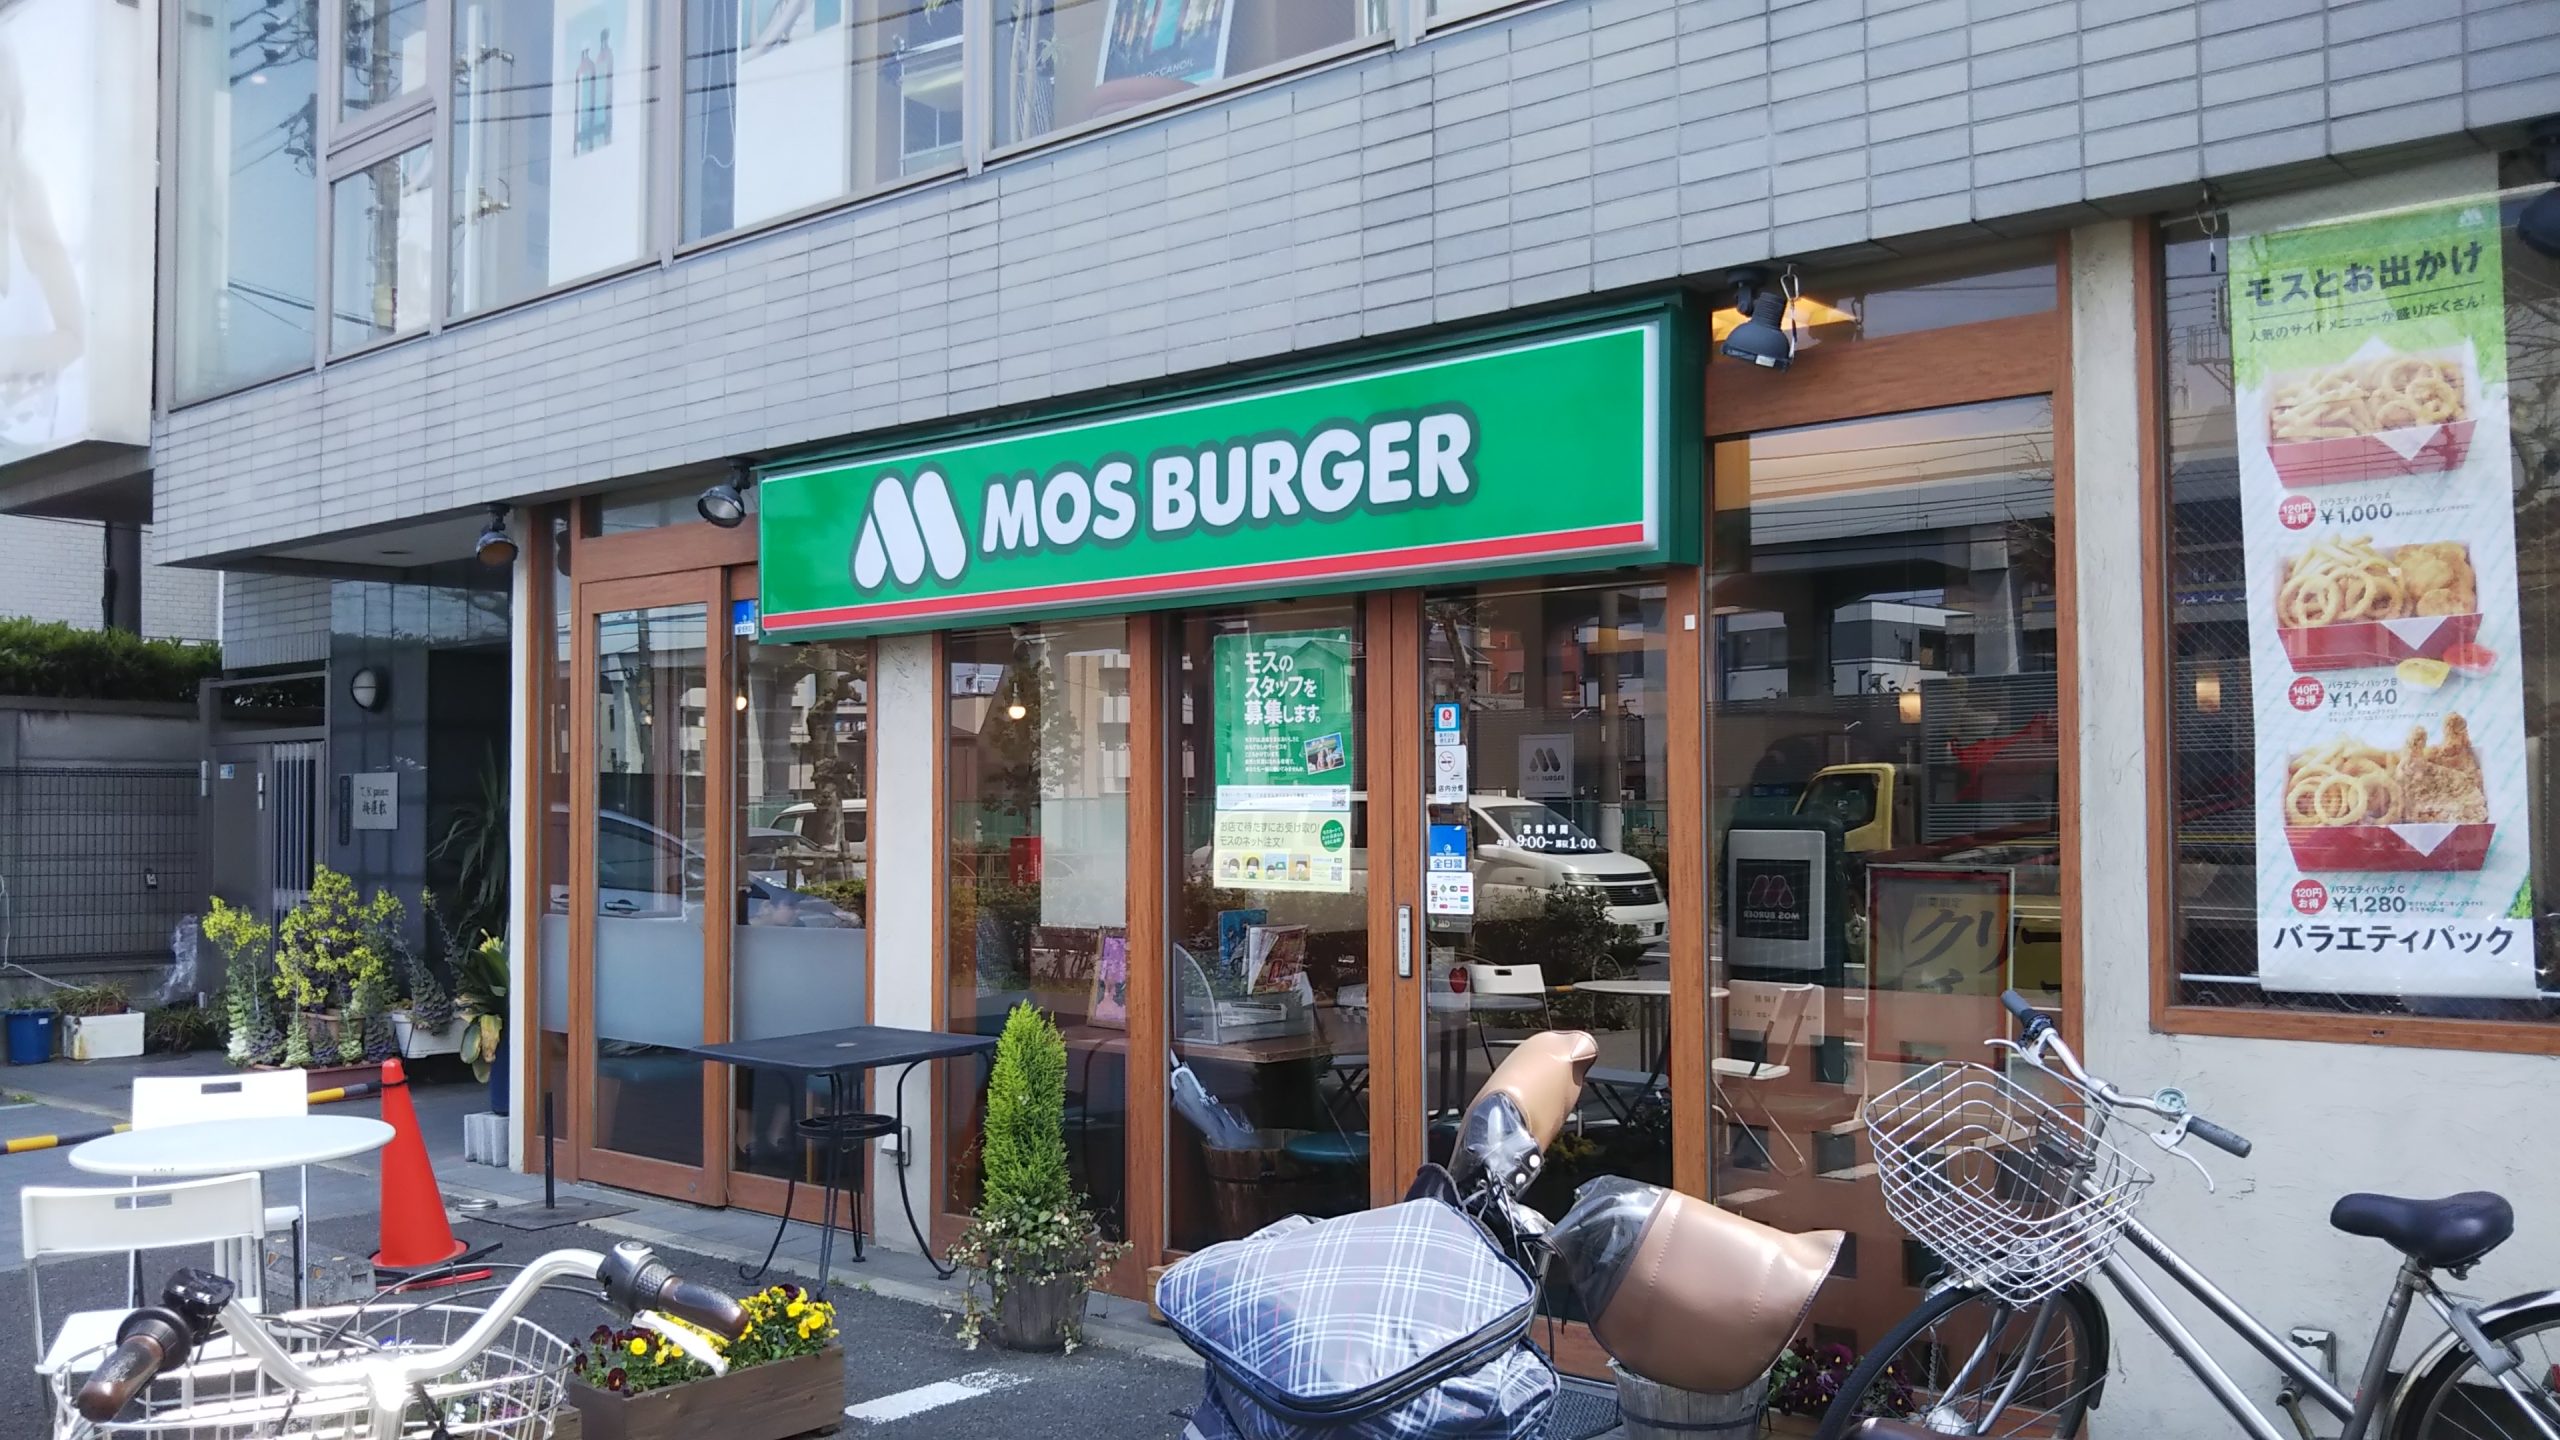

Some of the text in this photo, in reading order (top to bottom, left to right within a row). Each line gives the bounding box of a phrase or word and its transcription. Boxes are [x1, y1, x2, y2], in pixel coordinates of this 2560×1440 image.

[1136, 57, 1195, 79] OCCANOIL
[2245, 241, 2484, 307] モスとお出かけ
[981, 460, 1137, 553] MOS
[1151, 413, 1472, 533] BURGER
[2283, 503, 2312, 514] 120円
[2320, 502, 2394, 525] ¥1,000
[2287, 513, 2308, 525] お得
[1244, 651, 1294, 675] モスの
[1244, 676, 1317, 699] スタッフを
[2293, 684, 2319, 696] 140円
[2295, 695, 2317, 706] お得
[2328, 688, 2398, 709] ¥1,440
[1244, 700, 1321, 726] 募集します。
[1522, 824, 1569, 835] 営業時間
[1219, 836, 1285, 848] モスのネット注文!
[2295, 887, 2323, 898] 120円
[2298, 898, 2320, 910] お得
[2332, 896, 2407, 915] ¥1,280
[2273, 924, 2514, 956] バラエティパック
